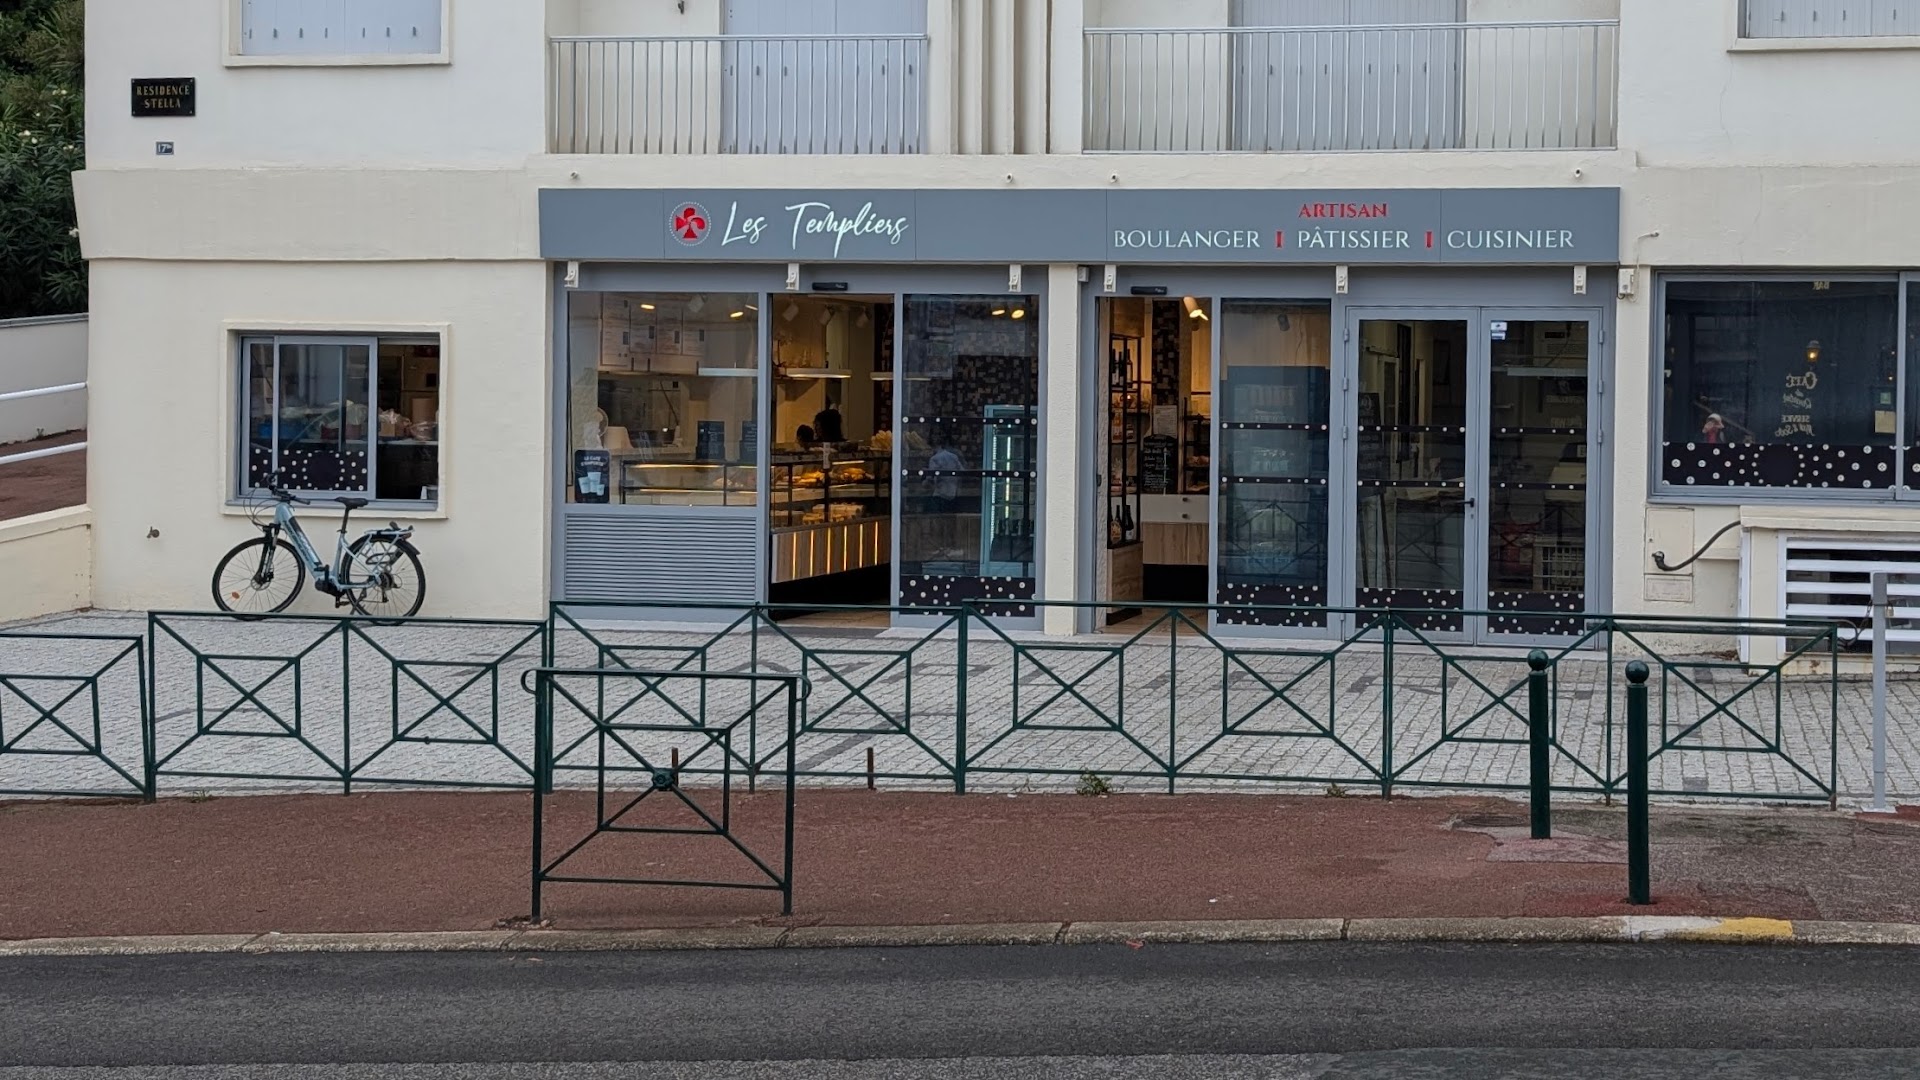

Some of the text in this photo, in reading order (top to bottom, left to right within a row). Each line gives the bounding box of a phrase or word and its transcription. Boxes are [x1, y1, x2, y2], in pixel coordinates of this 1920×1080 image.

[136, 85, 190, 96] RESIDENCE
[144, 98, 181, 108] STELLA
[1298, 203, 1387, 218] ARTISAN
[721, 201, 909, 259] Les Templiers
[1114, 230, 1261, 248] BOULANGER
[1297, 226, 1410, 248] PÂTISSIER
[1447, 230, 1574, 249] CUISINIER
